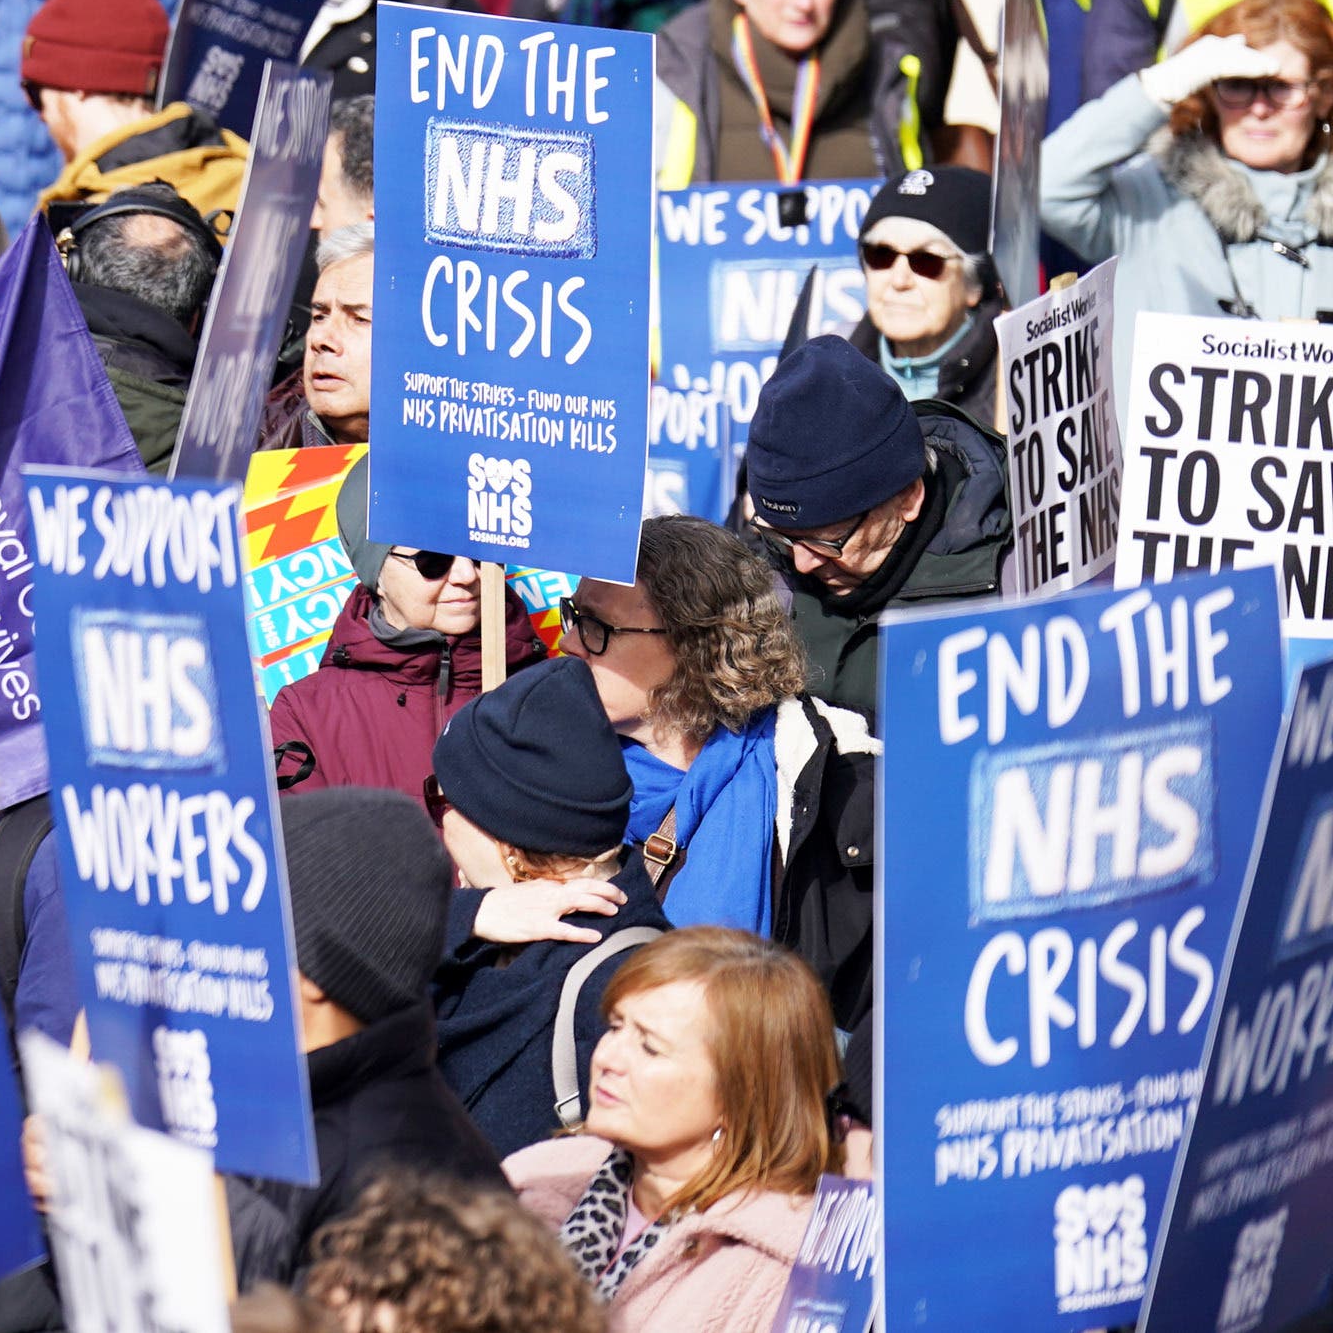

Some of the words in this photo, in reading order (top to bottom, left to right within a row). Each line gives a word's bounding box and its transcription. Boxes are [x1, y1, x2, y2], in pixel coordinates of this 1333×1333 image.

[410, 26, 505, 111] END
[519, 30, 616, 126] THE
[432, 135, 583, 244] NHS
[659, 189, 732, 246] WE
[421, 254, 593, 366] CRISIS
[1026, 306, 1071, 343] Socialist
[1202, 334, 1298, 363] Socialist
[403, 371, 450, 398] SUPPORT
[450, 376, 470, 401] THE
[471, 380, 516, 407] STRIKES
[528, 390, 563, 413] FUND
[564, 394, 590, 416] OUR
[591, 398, 617, 421] NHS
[403, 399, 436, 429] NHS
[439, 402, 564, 449] PRIVATISATION
[570, 417, 618, 455] KILLS
[1009, 316, 1100, 437] STRIKE
[1013, 429, 1045, 517] TO
[1056, 388, 1115, 494] SAVE
[1140, 446, 1221, 526] TO
[28, 484, 90, 576] WE
[92, 484, 240, 594] SUPPORT
[467, 492, 533, 536] NHS
[469, 529, 531, 548] SOSNHS.ORG
[1019, 502, 1069, 598] THE
[1079, 465, 1122, 567] NHS
[83, 626, 212, 759] NHS
[937, 616, 1091, 746] END
[1099, 586, 1234, 717] THE
[61, 782, 269, 916] WORKERS
[984, 745, 1203, 904] NHS
[964, 906, 1215, 1067] CRISIS
[935, 1134, 999, 1186] NHS
[1001, 1104, 1183, 1179] PRIVATISATION
[1054, 1232, 1148, 1298] NHS
